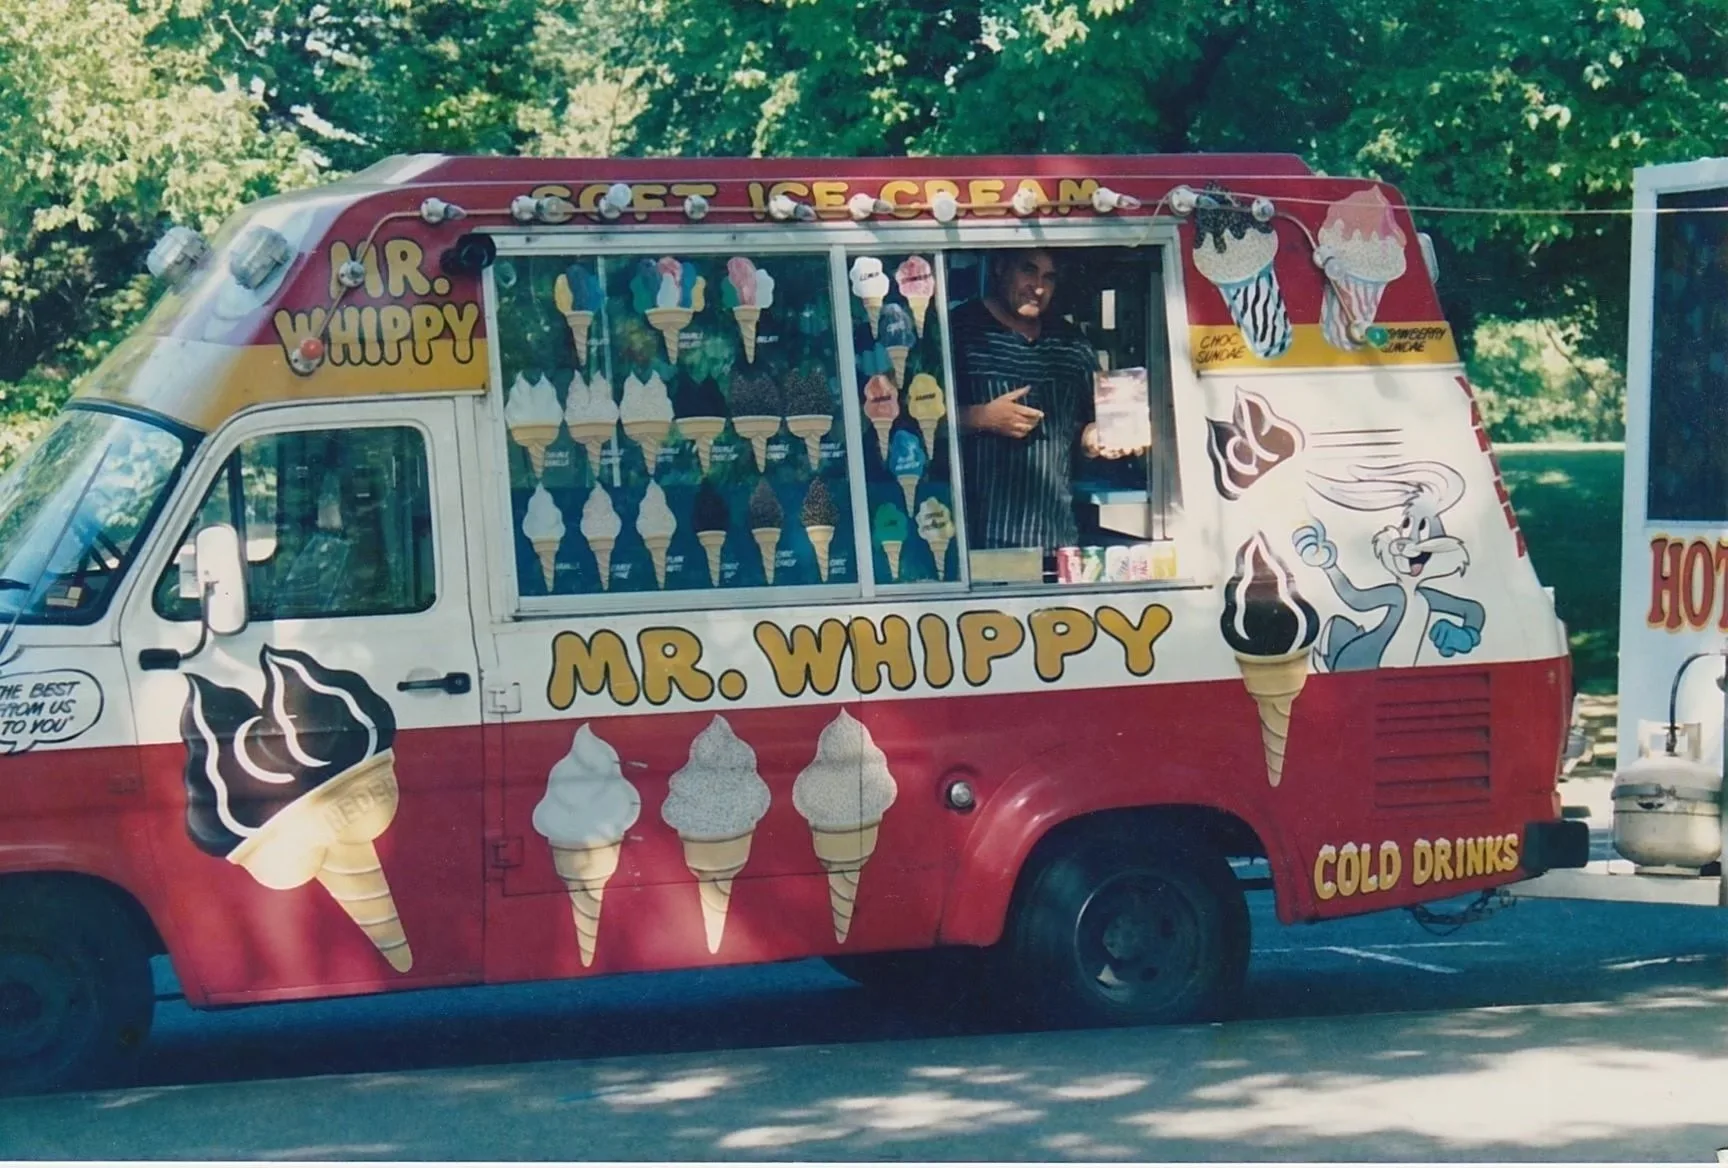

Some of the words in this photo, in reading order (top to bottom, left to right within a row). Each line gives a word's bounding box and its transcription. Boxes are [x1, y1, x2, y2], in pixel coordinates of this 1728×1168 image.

[530, 182, 717, 223] SOFT
[748, 180, 850, 220] ICE
[879, 178, 1102, 217] CREAM
[329, 237, 451, 299] MR.
[273, 301, 479, 377] WHIPPY
[1195, 345, 1246, 364] SUNDAE
[1200, 333, 1240, 349] CHOC
[547, 628, 748, 710] MR.
[753, 602, 1173, 698] WHIPPY
[0, 684, 23, 700] THE
[29, 681, 81, 699] BEST
[49, 699, 76, 715] US
[2, 719, 27, 736] TO
[1313, 840, 1402, 900] COLD
[1412, 833, 1520, 886] DRINKS
